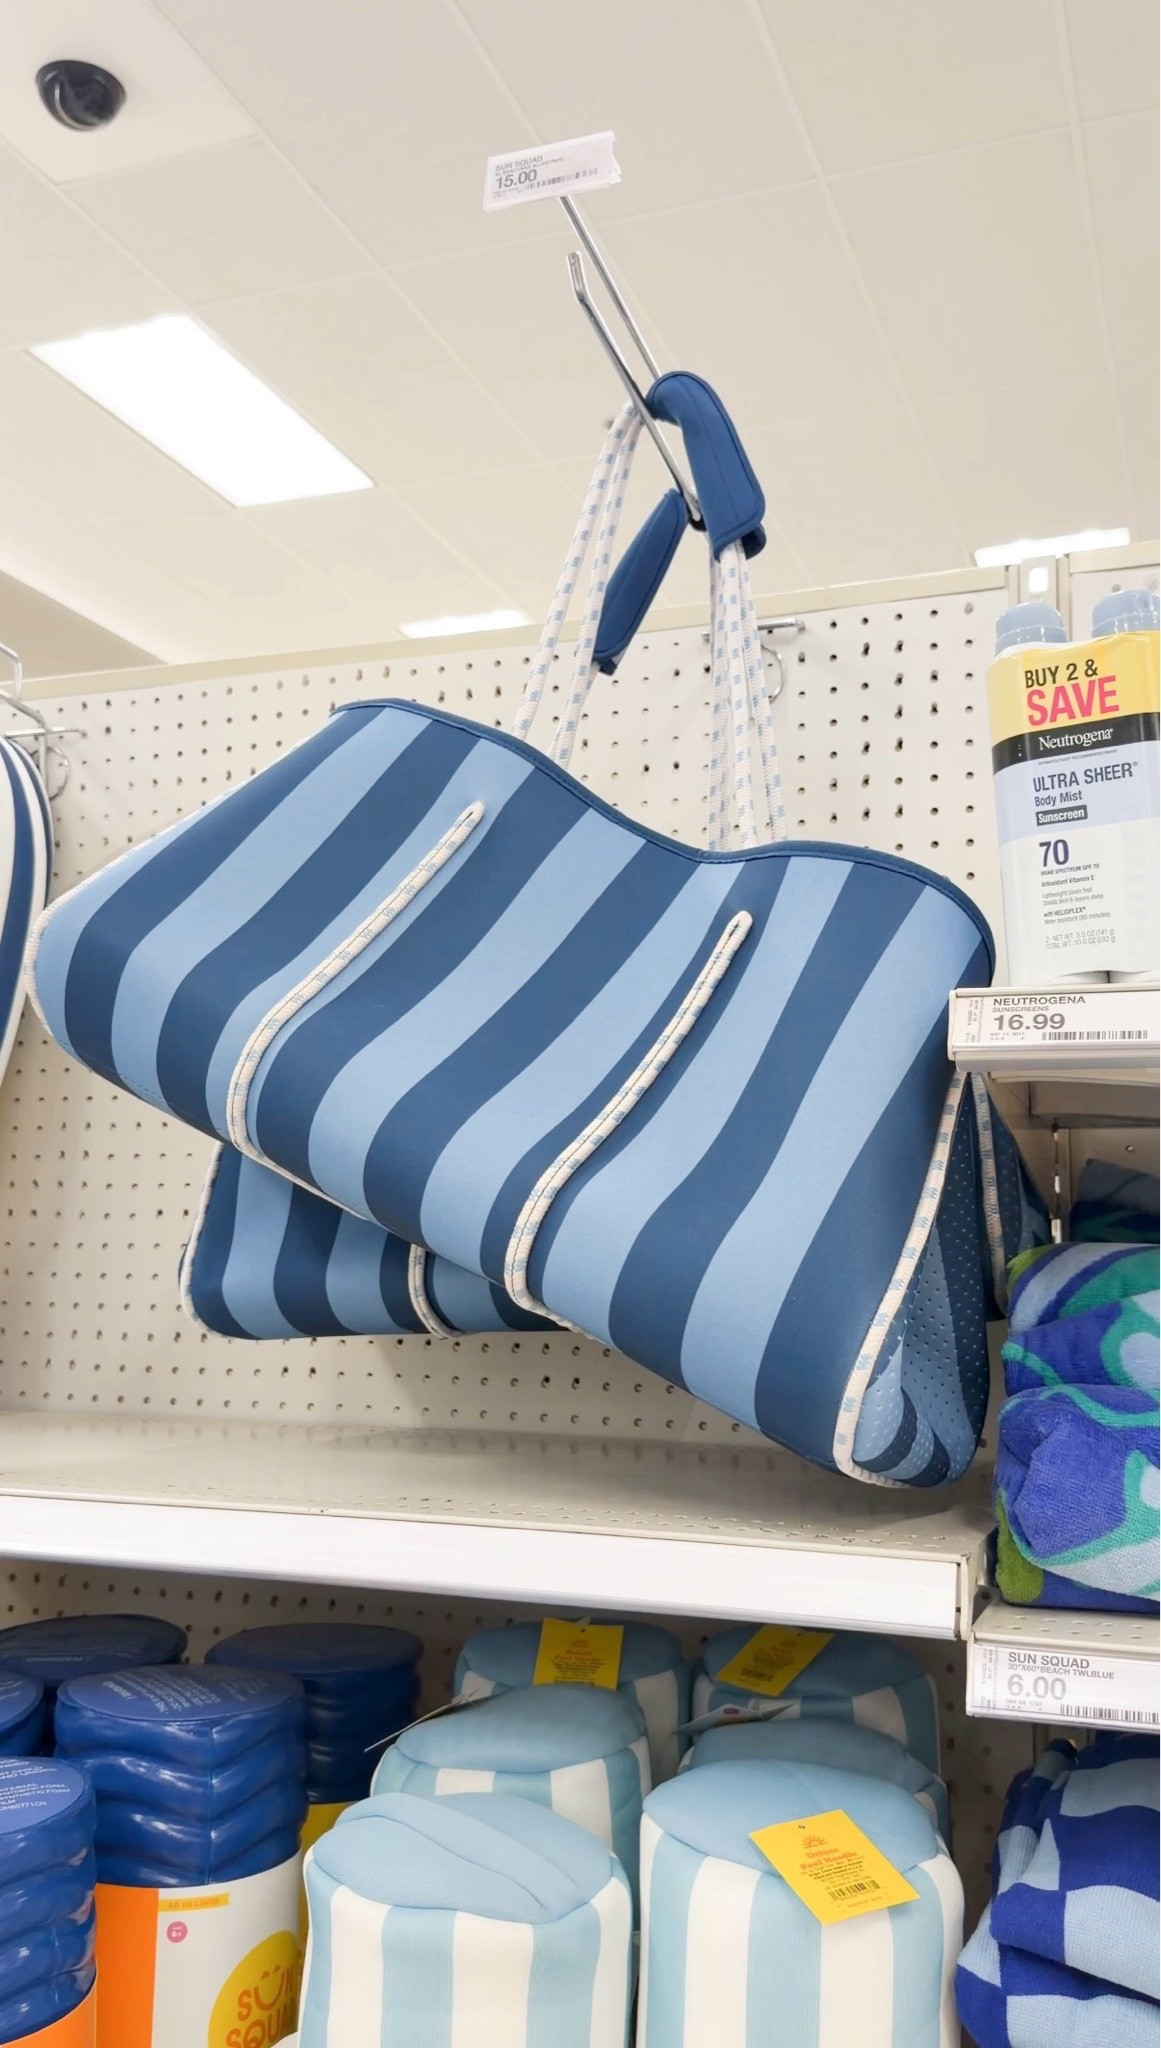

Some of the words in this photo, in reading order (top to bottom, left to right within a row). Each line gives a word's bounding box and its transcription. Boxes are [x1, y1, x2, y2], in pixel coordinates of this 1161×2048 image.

[495, 163, 512, 172] SUN
[515, 155, 543, 167] SQUAD
[496, 169, 537, 189] 15.00
[1025, 665, 1059, 688] BUY
[1066, 663, 1078, 681] 2
[1084, 659, 1098, 677] &
[1027, 675, 1119, 727] SAVE
[1033, 771, 1079, 792] ULTRA
[1035, 795, 1056, 807] Body
[1060, 790, 1083, 803] Mist
[1038, 809, 1085, 824] Sunscreen
[1039, 839, 1069, 868] 70
[1055, 866, 1081, 874] SPECTRUM
[1069, 876, 1090, 884] Vitamin
[993, 996, 1086, 1006] NEUTROGENA
[993, 1013, 1066, 1030] 16.99
[1008, 1652, 1037, 1665] SUN
[1041, 1655, 1090, 1669] SQUAD
[1073, 1668, 1115, 1679] TWLBLUE
[1007, 1674, 1067, 1700] 6.00
